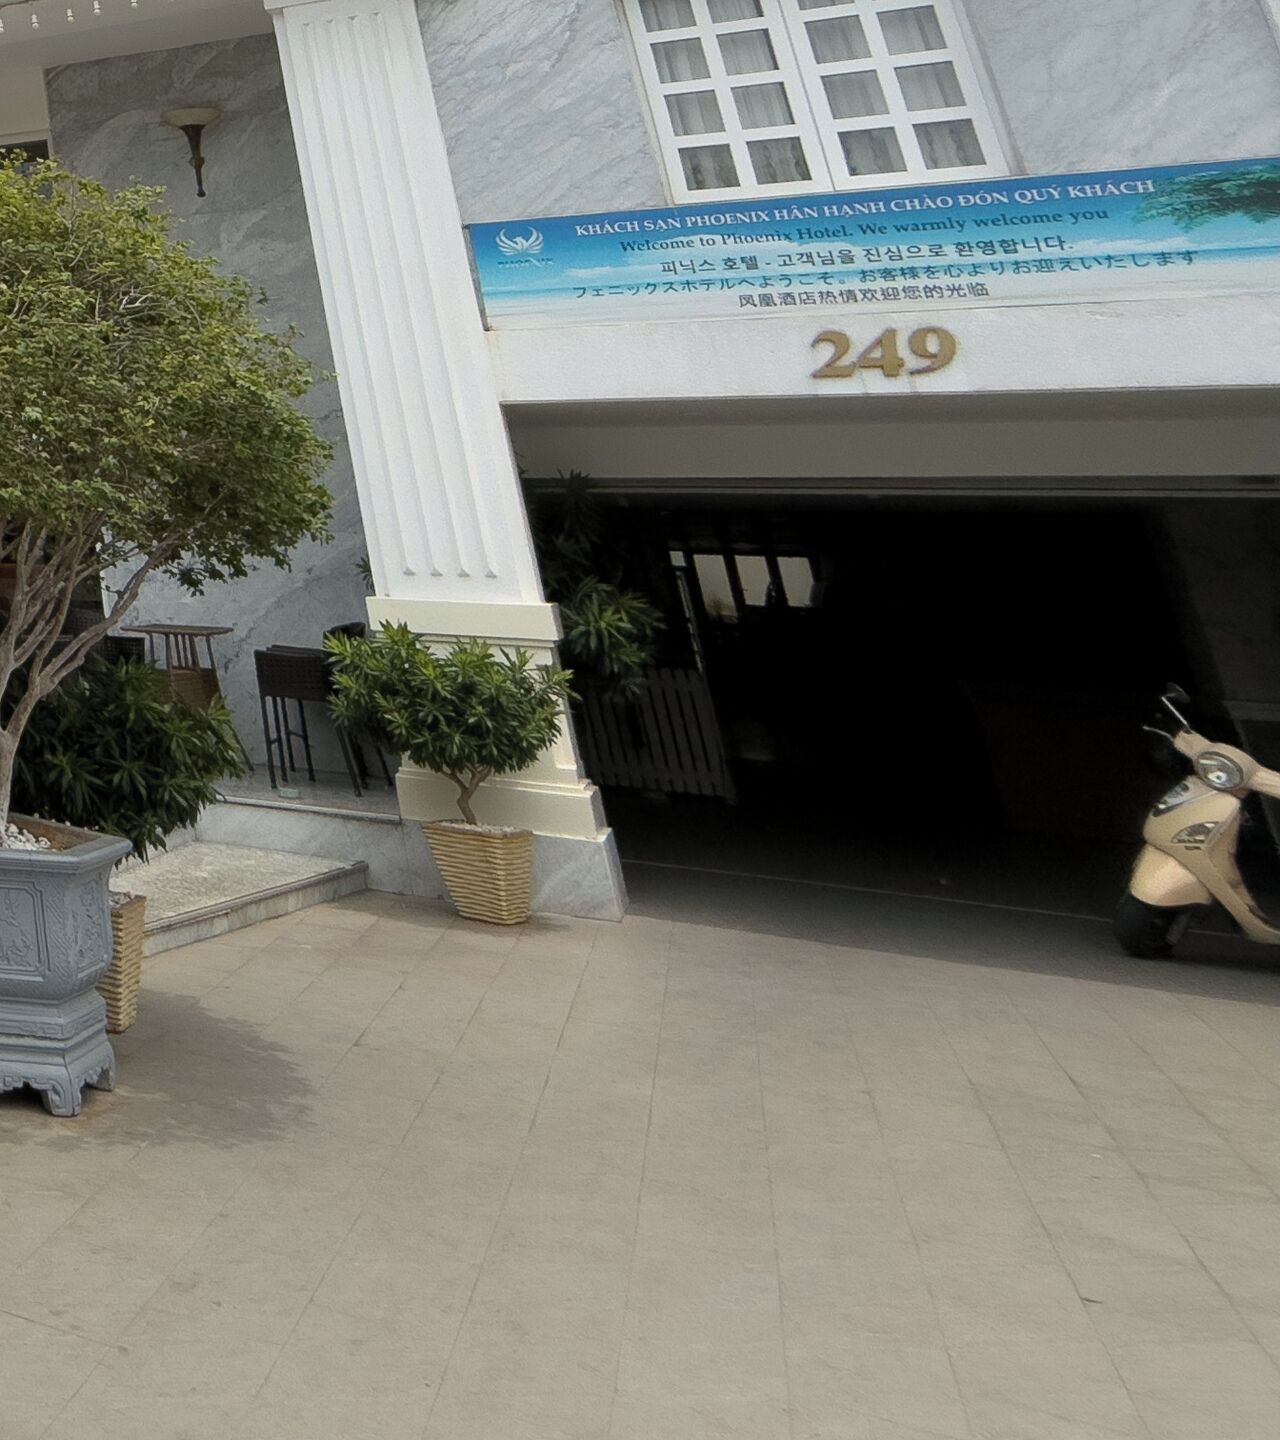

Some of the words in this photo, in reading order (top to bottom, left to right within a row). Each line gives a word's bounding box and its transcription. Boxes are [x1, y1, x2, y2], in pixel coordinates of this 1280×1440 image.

[575, 218, 640, 237] KHÁCH
[643, 216, 681, 236] SẠN
[686, 210, 769, 228] PHOENIX
[774, 205, 819, 221] HÂN
[823, 201, 886, 218] HẠNH
[890, 193, 953, 212] CHÀO
[958, 187, 1010, 208] ĐÓN
[1014, 183, 1062, 205] QUÝ
[1067, 178, 1156, 199] KHÁCH
[620, 236, 696, 253] Welcome
[699, 236, 717, 248] to
[721, 231, 792, 246] Phoenix
[797, 225, 853, 241] Hotel.
[858, 222, 888, 236] We
[892, 217, 966, 233] warmly
[972, 212, 1062, 228] welcome
[1069, 208, 1110, 226] you
[660, 257, 717, 276] 피닉스
[721, 254, 759, 272] 호텔
[778, 248, 856, 267] 고객님을
[863, 243, 946, 264] 진심으로
[954, 234, 1074, 259] 환영합니다.
[738, 282, 990, 308] 凤凰酒店热情欢迎您的光临
[811, 326, 957, 378] 249
